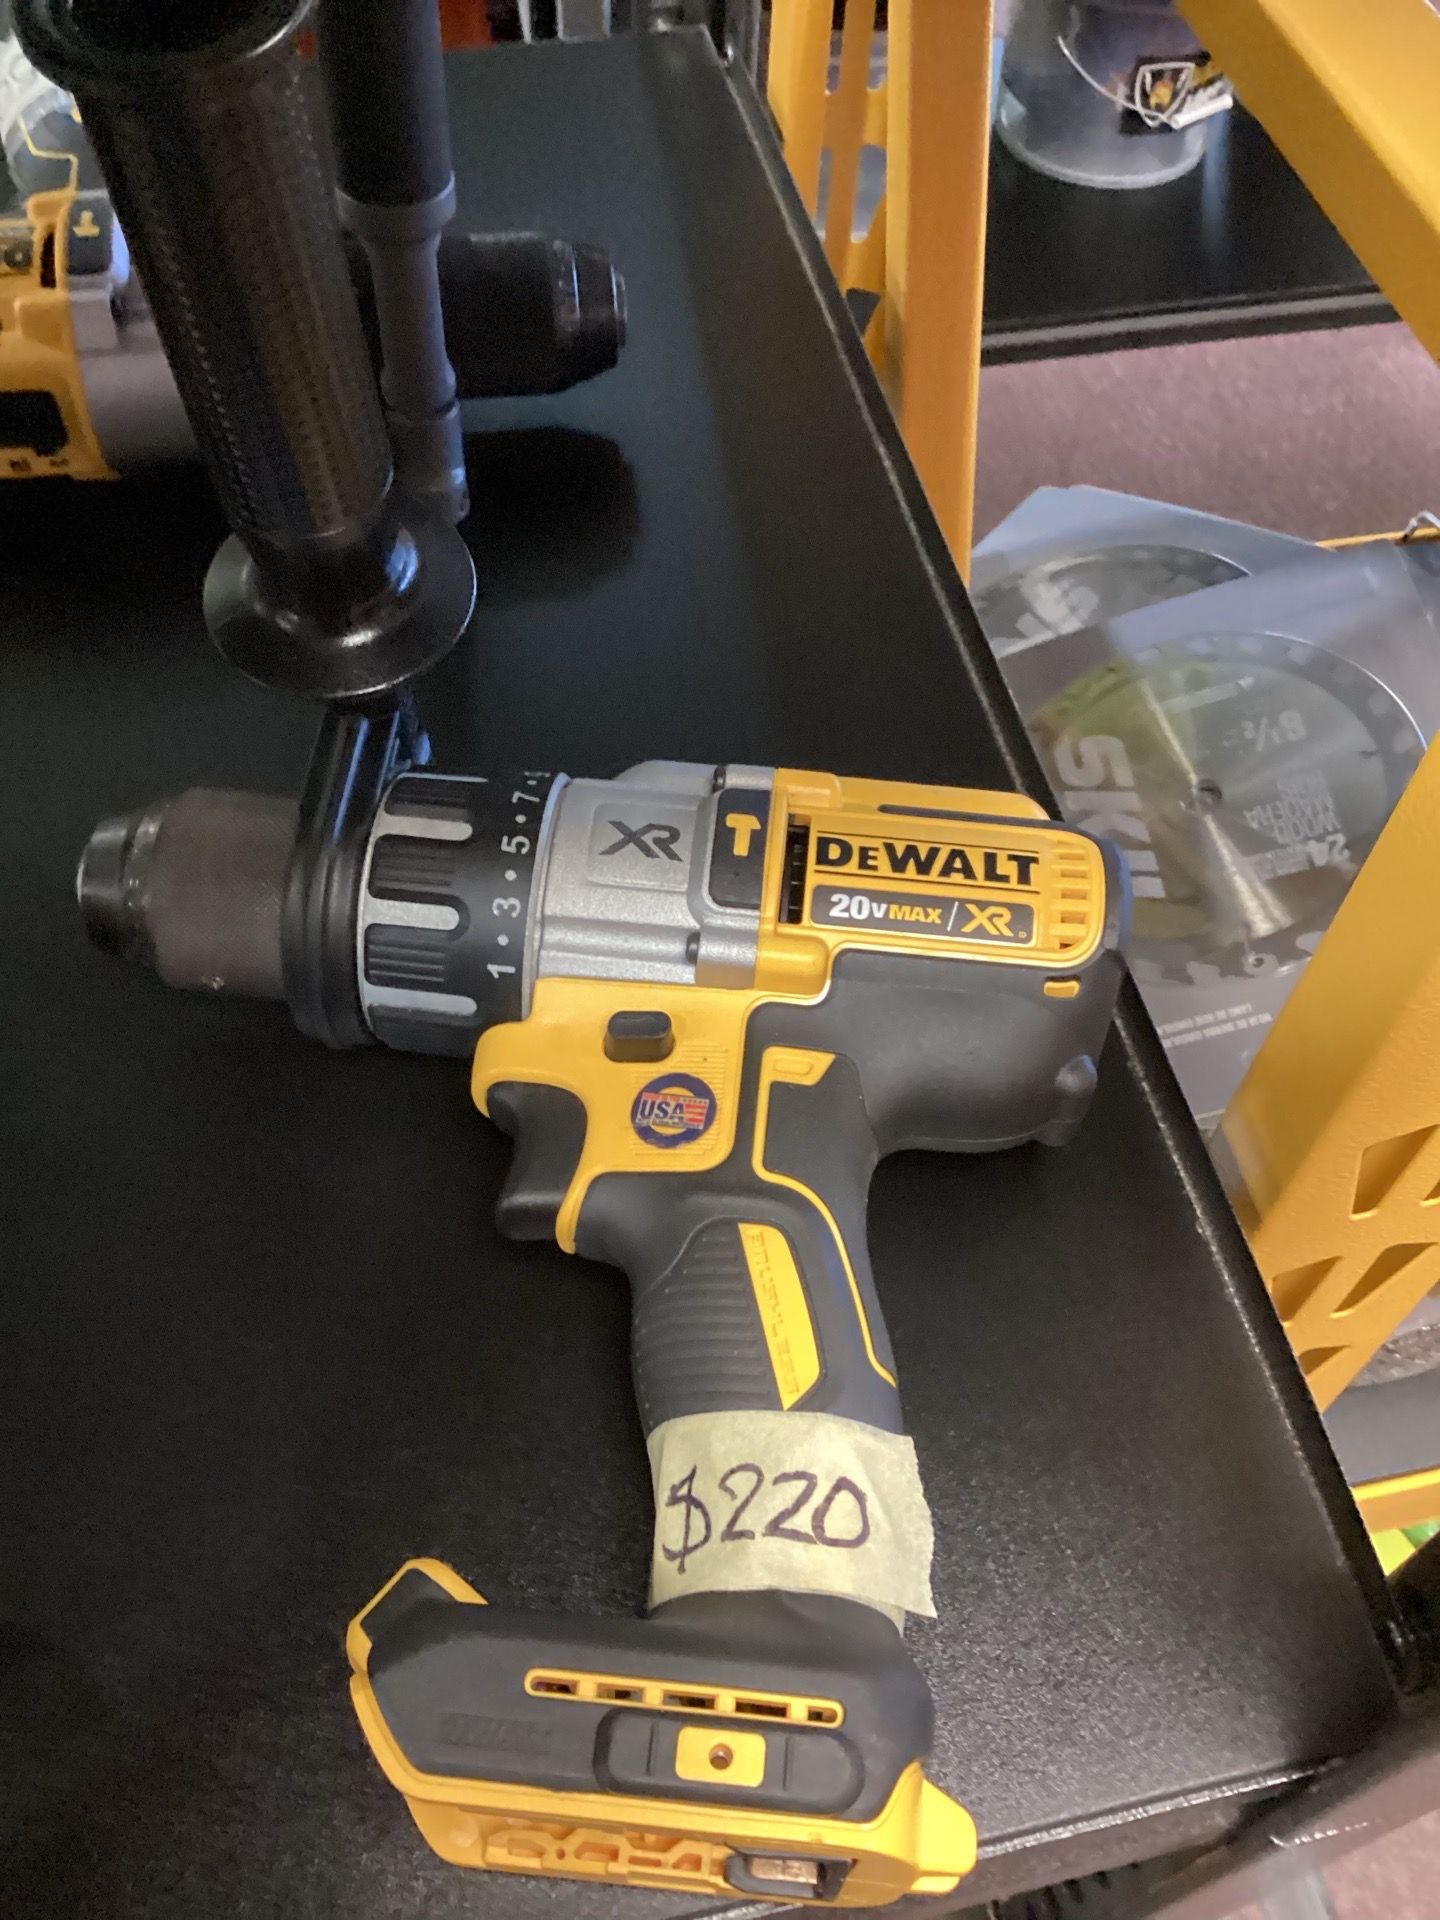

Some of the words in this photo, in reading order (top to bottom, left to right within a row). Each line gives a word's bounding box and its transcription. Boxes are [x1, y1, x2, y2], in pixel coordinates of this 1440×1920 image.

[511, 790, 540, 804] 7
[500, 835, 530, 854] 5
[598, 820, 683, 862] XR
[492, 897, 521, 918] 3
[889, 903, 942, 924] MAX
[486, 963, 516, 979] 1
[640, 1099, 684, 1120] USA
[662, 1463, 871, 1575] $220
